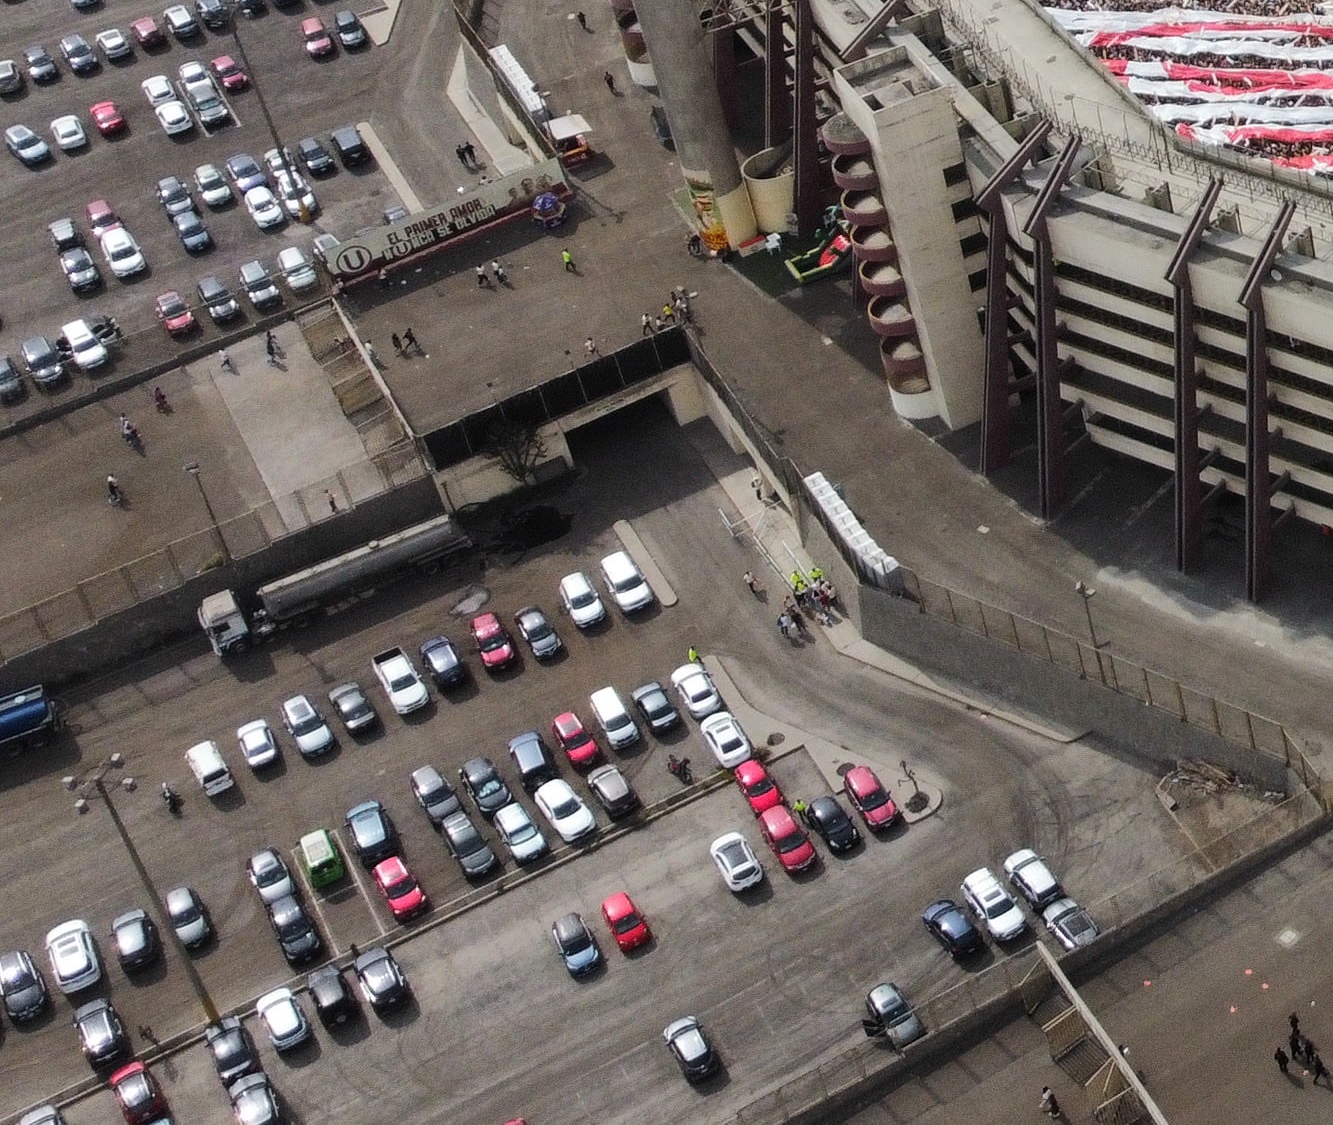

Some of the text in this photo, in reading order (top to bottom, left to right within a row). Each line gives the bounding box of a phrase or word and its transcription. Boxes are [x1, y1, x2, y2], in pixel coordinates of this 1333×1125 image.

[387, 198, 484, 246] EL PRIMER AMOR
[437, 223, 453, 239] SE
[455, 205, 497, 231] OLVIDA
